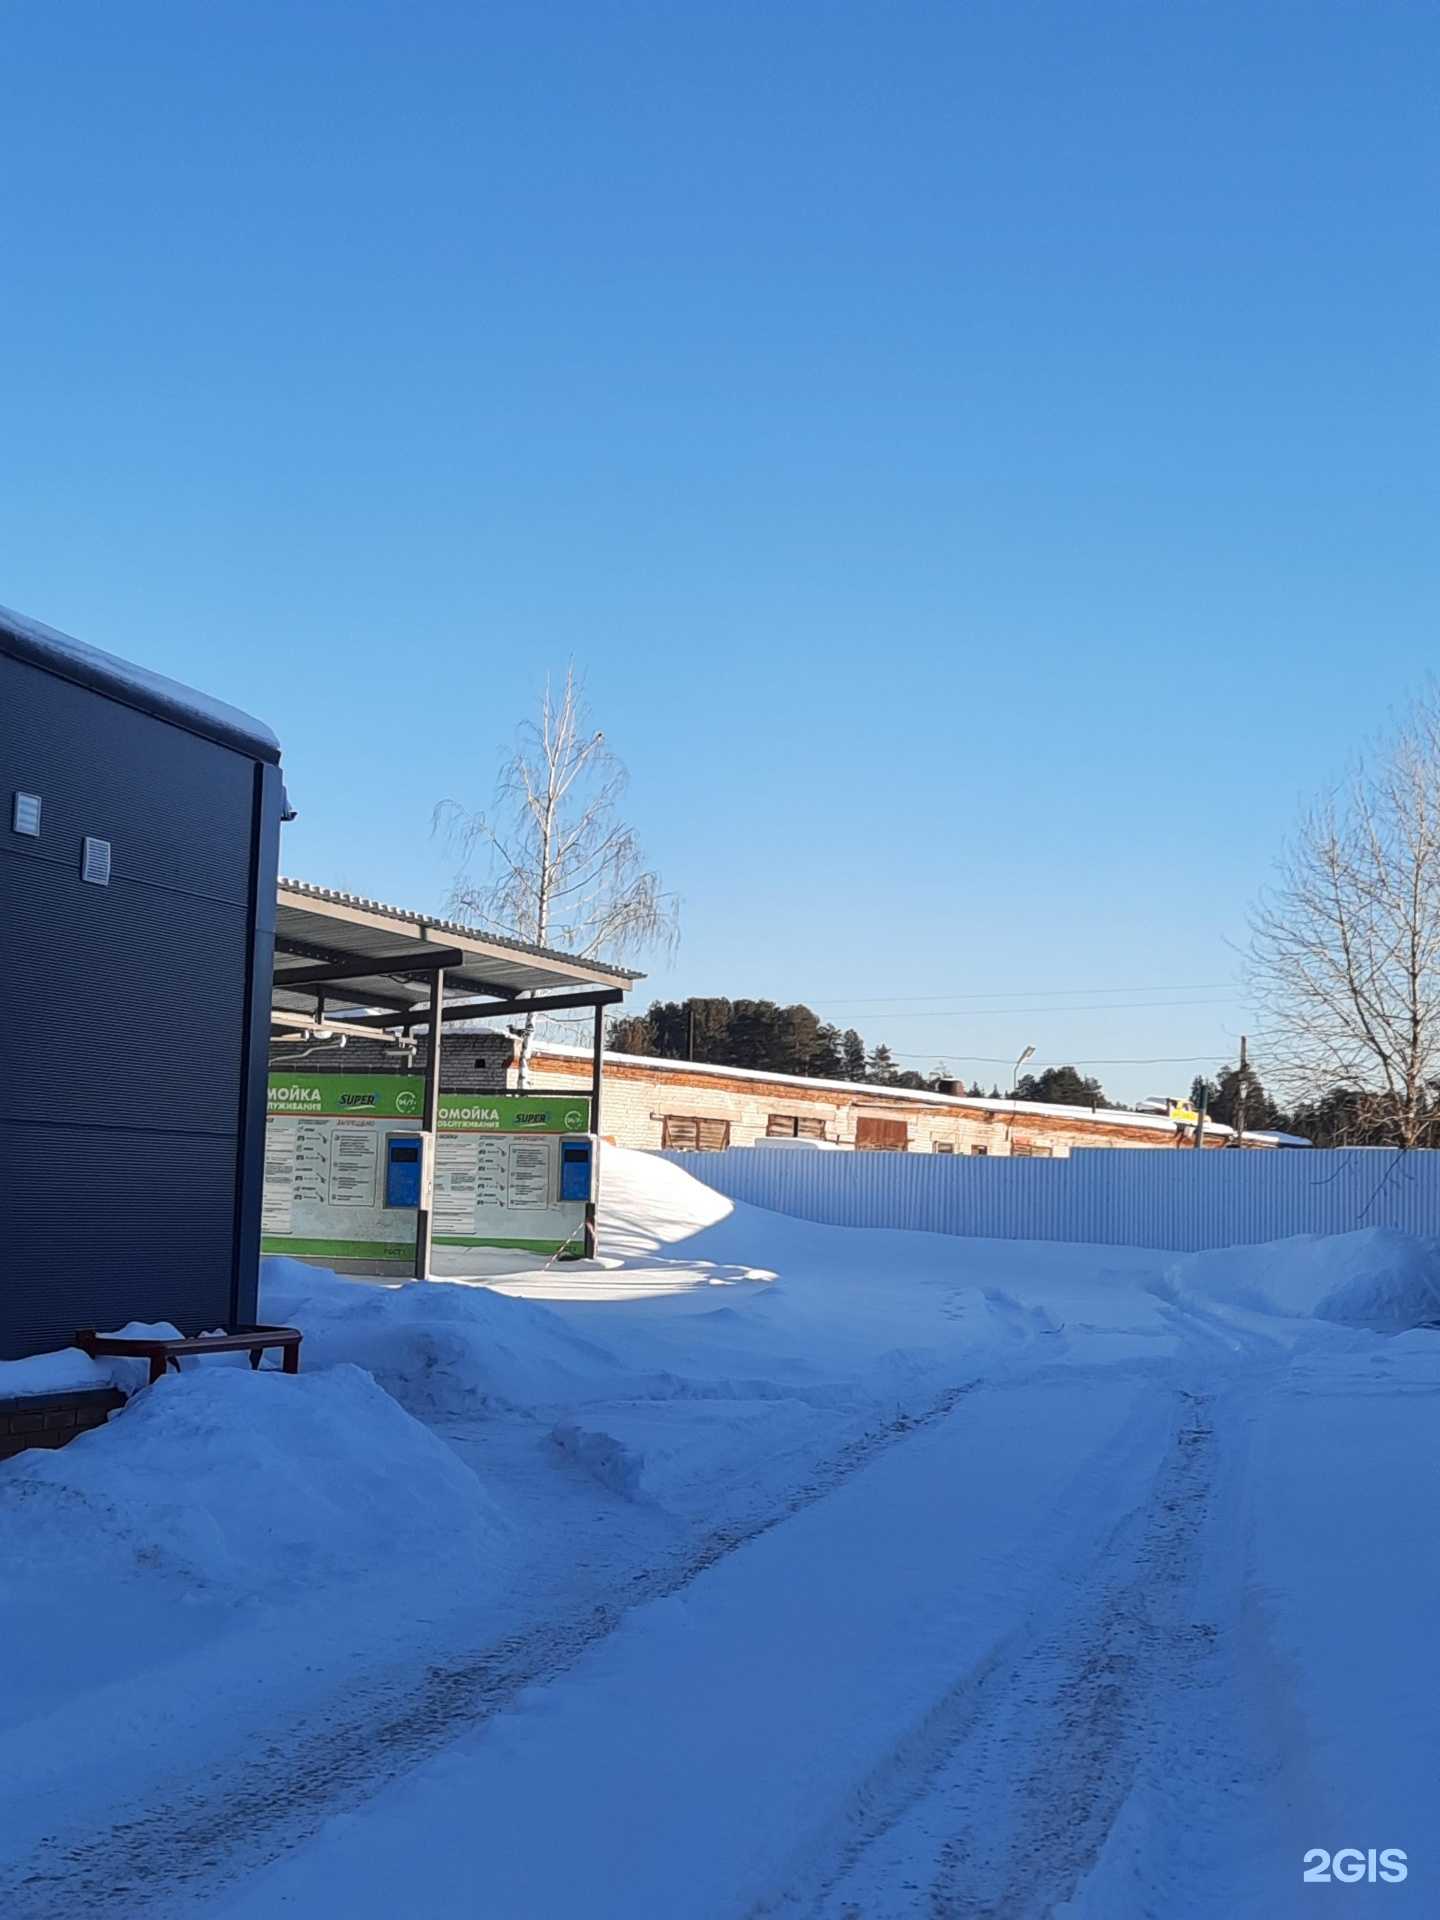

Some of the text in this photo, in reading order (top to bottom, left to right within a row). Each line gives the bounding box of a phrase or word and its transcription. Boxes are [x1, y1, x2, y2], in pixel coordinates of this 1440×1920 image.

[339, 1094, 376, 1105] SUPER
[438, 1106, 500, 1120] ОМОЙКА
[516, 1112, 546, 1123] SUPER
